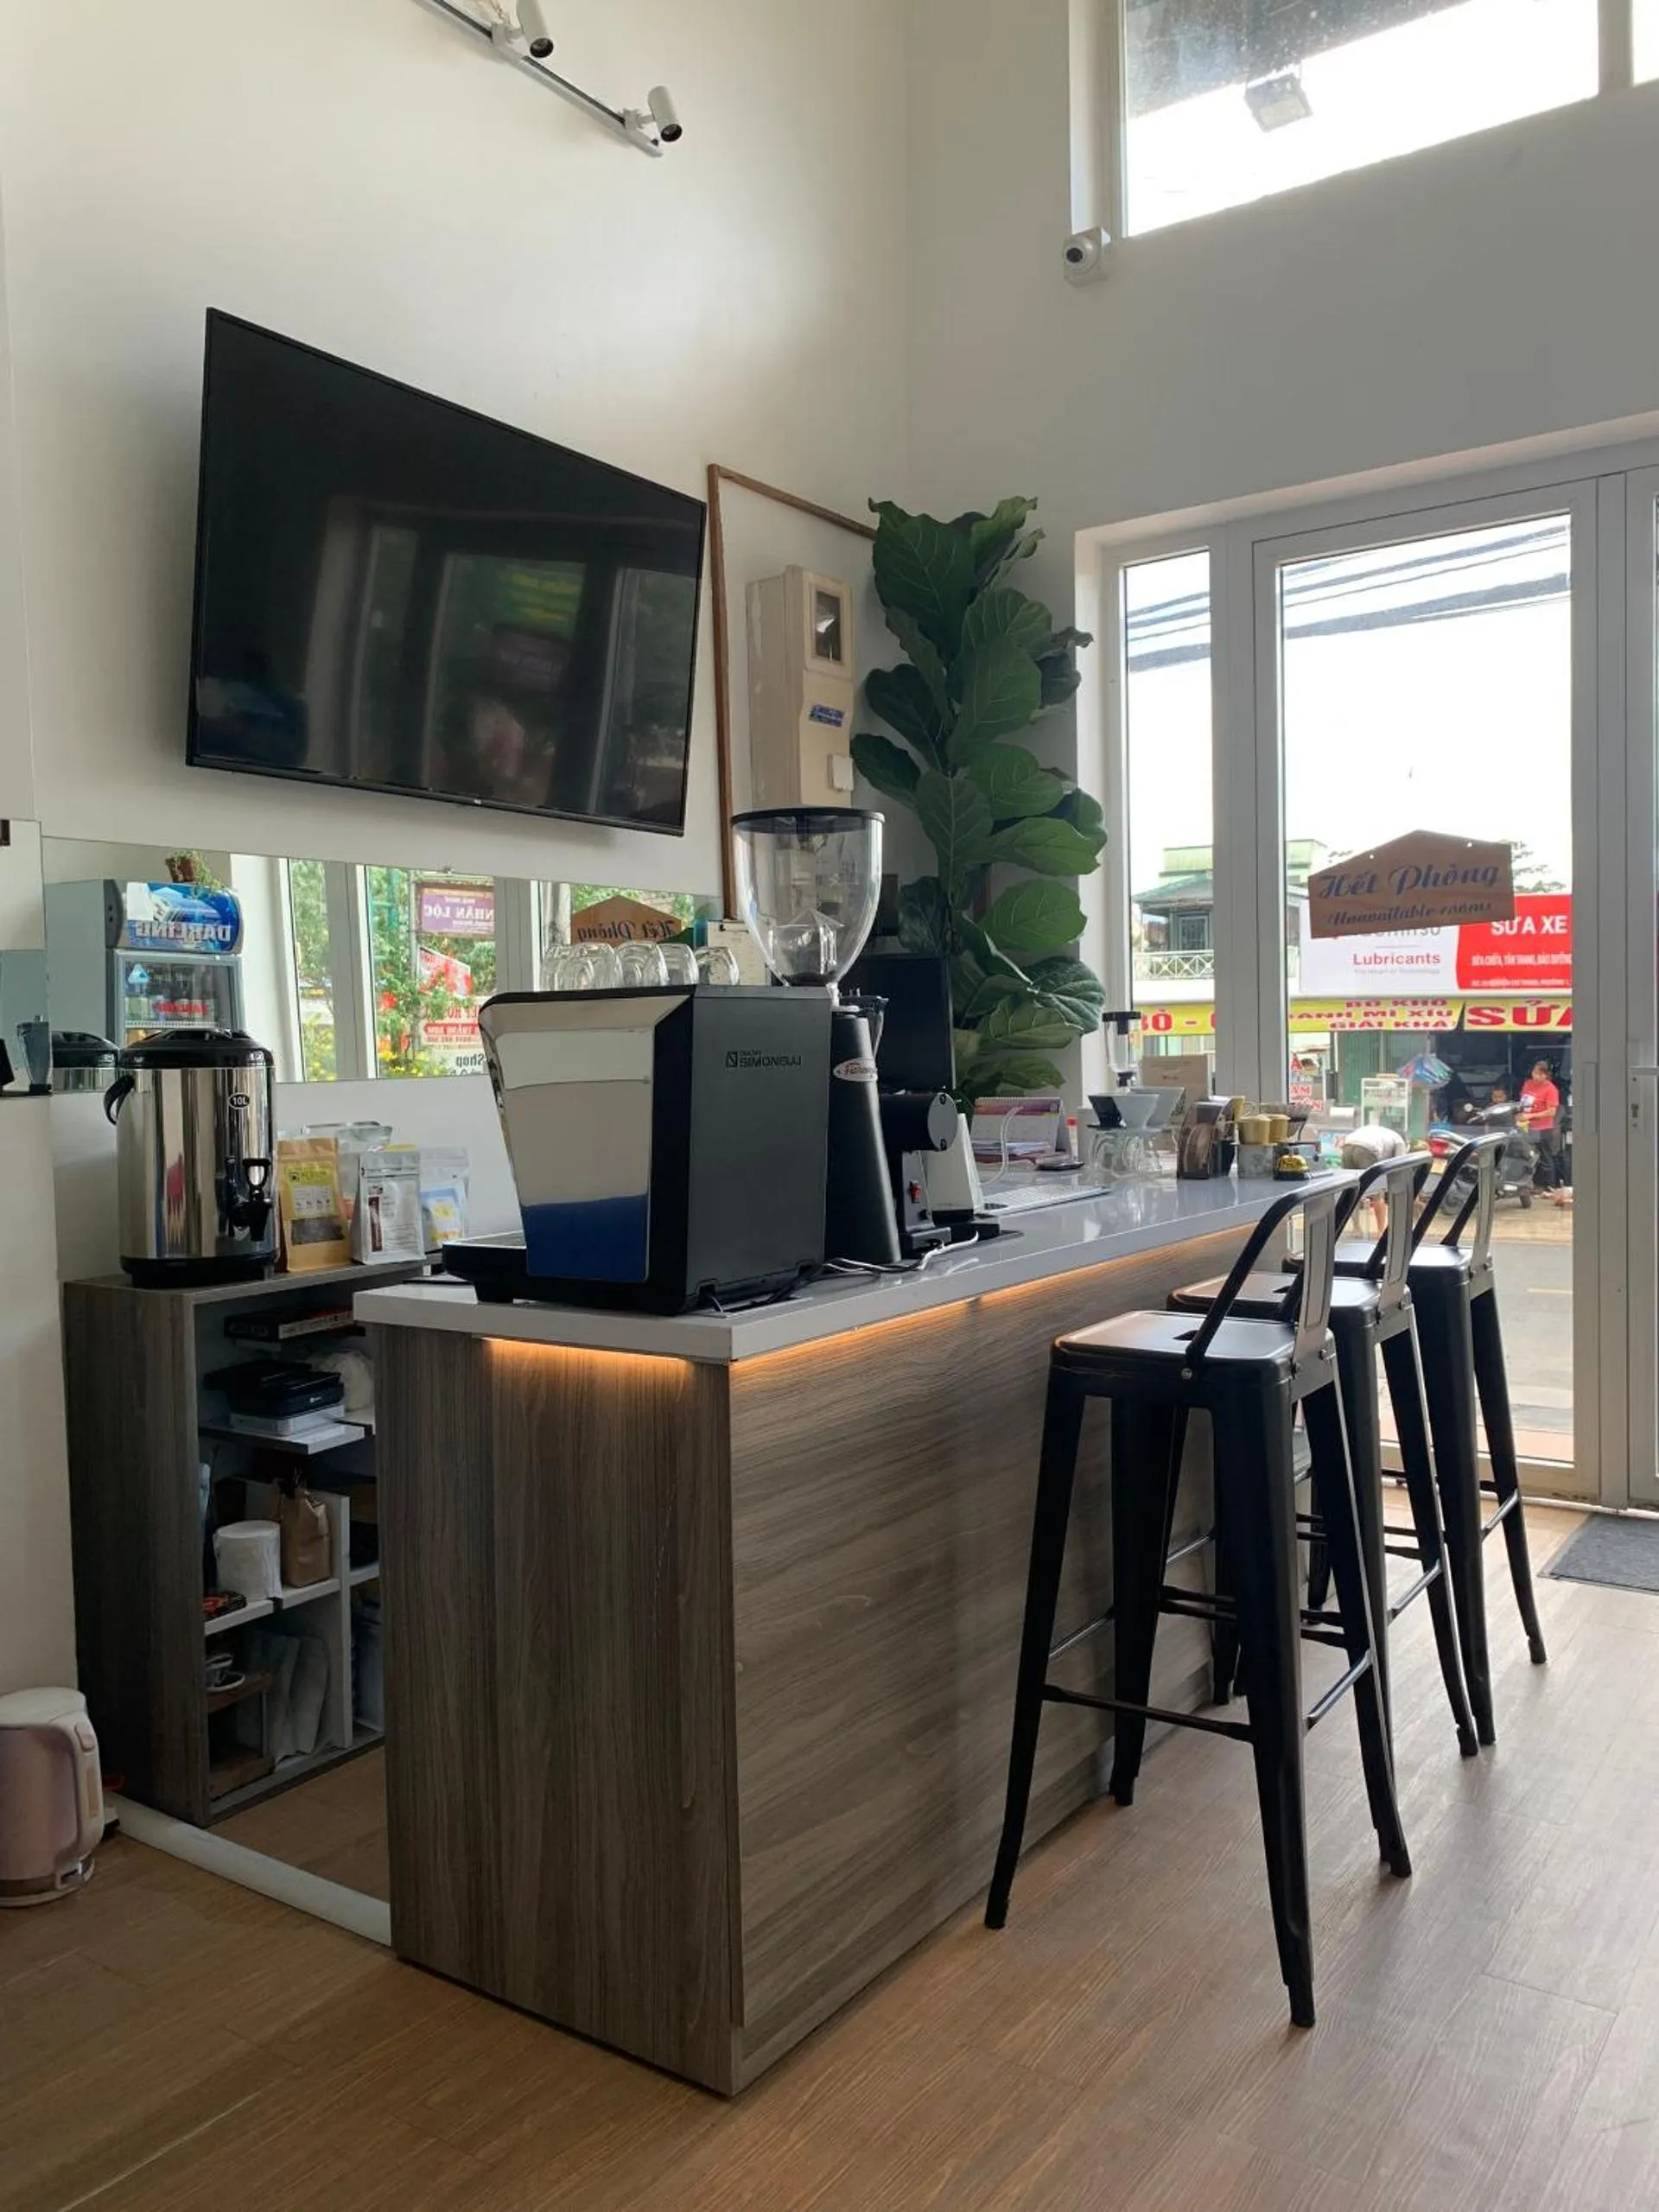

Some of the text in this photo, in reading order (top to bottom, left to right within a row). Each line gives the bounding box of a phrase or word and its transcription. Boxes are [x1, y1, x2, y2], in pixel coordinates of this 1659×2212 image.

[1541, 914, 1569, 935] XE
[1353, 952, 1441, 966] Lubricants
[232, 1096, 248, 1106] 10L
